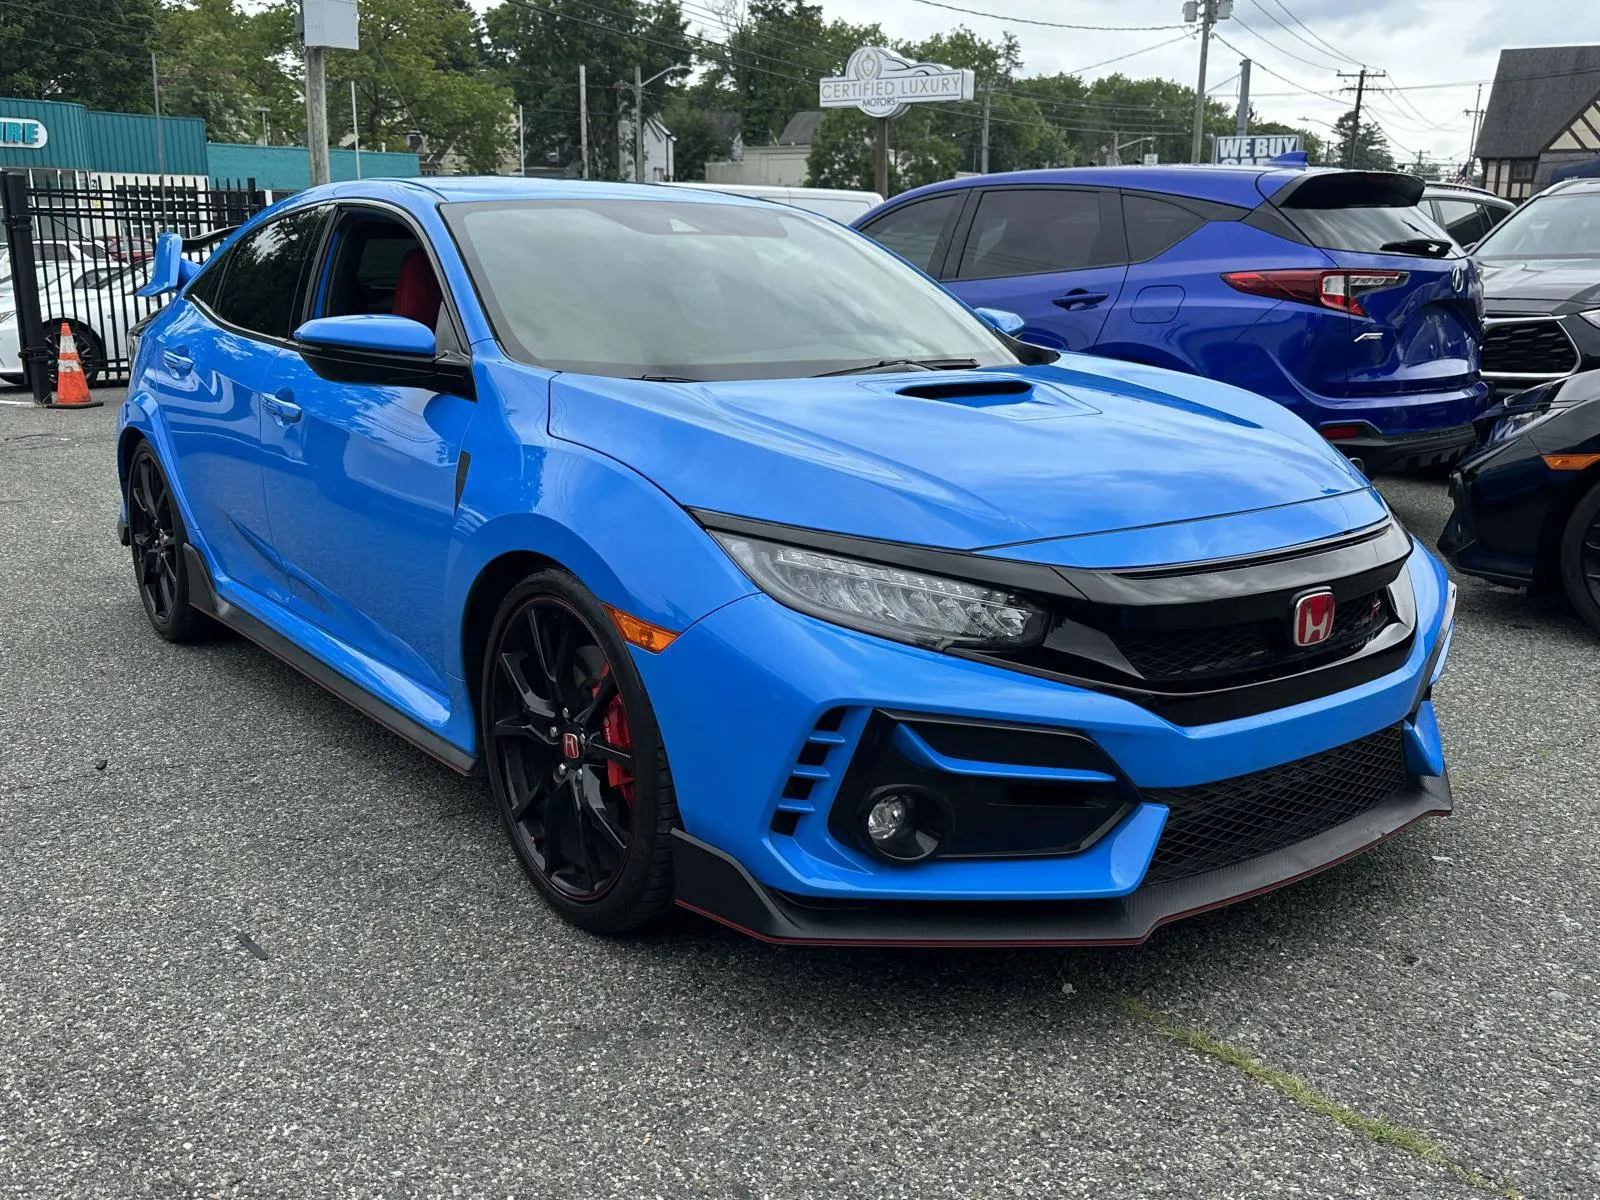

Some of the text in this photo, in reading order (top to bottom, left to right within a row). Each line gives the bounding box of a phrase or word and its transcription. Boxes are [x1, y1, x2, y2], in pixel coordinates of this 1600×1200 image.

[821, 76, 961, 99] CERTIFIED LUXURY
[862, 96, 897, 108] MOTORS
[1219, 137, 1297, 158] WE BUY
